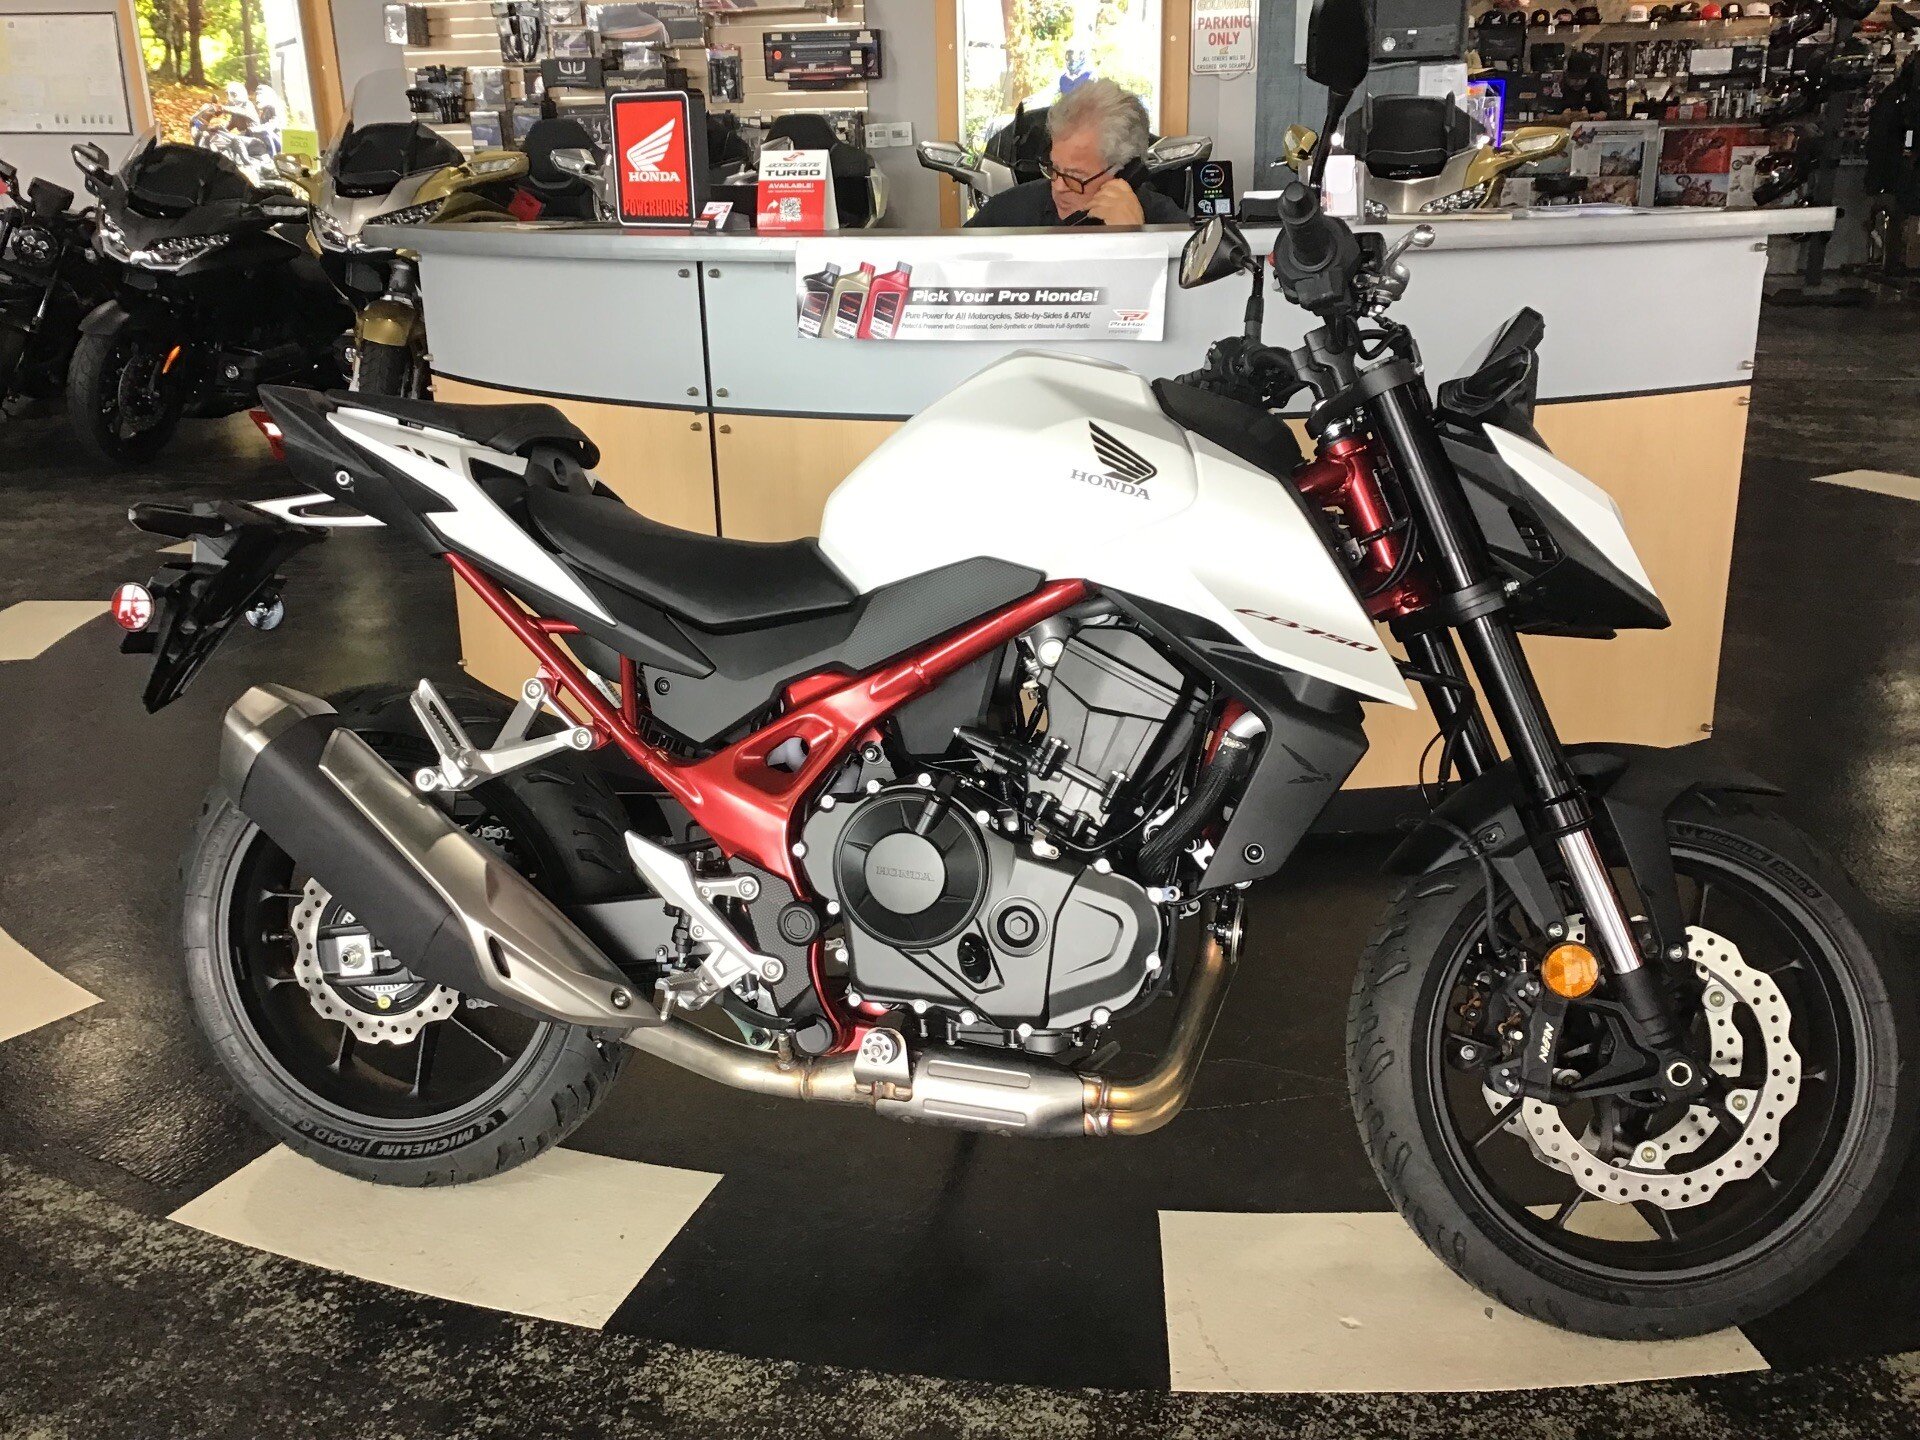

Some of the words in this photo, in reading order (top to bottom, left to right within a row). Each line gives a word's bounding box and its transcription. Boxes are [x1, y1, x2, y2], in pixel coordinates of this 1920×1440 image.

[1198, 15, 1251, 30] PARKING
[1208, 32, 1240, 46] ONLY
[628, 171, 681, 182] HONDA
[765, 169, 821, 177] TURBO
[623, 199, 689, 218] POWERHOUSE
[911, 289, 950, 302] Pick
[953, 290, 994, 302] Your
[997, 290, 1030, 302] Pro
[1034, 289, 1099, 302] Honda!
[905, 311, 921, 320] Pure
[922, 311, 944, 320] Power
[945, 311, 954, 320] for
[955, 311, 966, 320] All
[967, 311, 1012, 321] Motorcycles,
[1014, 311, 1063, 320] Side-by-Sides
[1064, 311, 1070, 319] &
[1071, 311, 1092, 319] ATVs!
[1070, 468, 1151, 501] HONDA
[875, 865, 935, 882] HONDA
[314, 1127, 367, 1152] ROAD
[376, 1128, 475, 1157] MICHELIN
